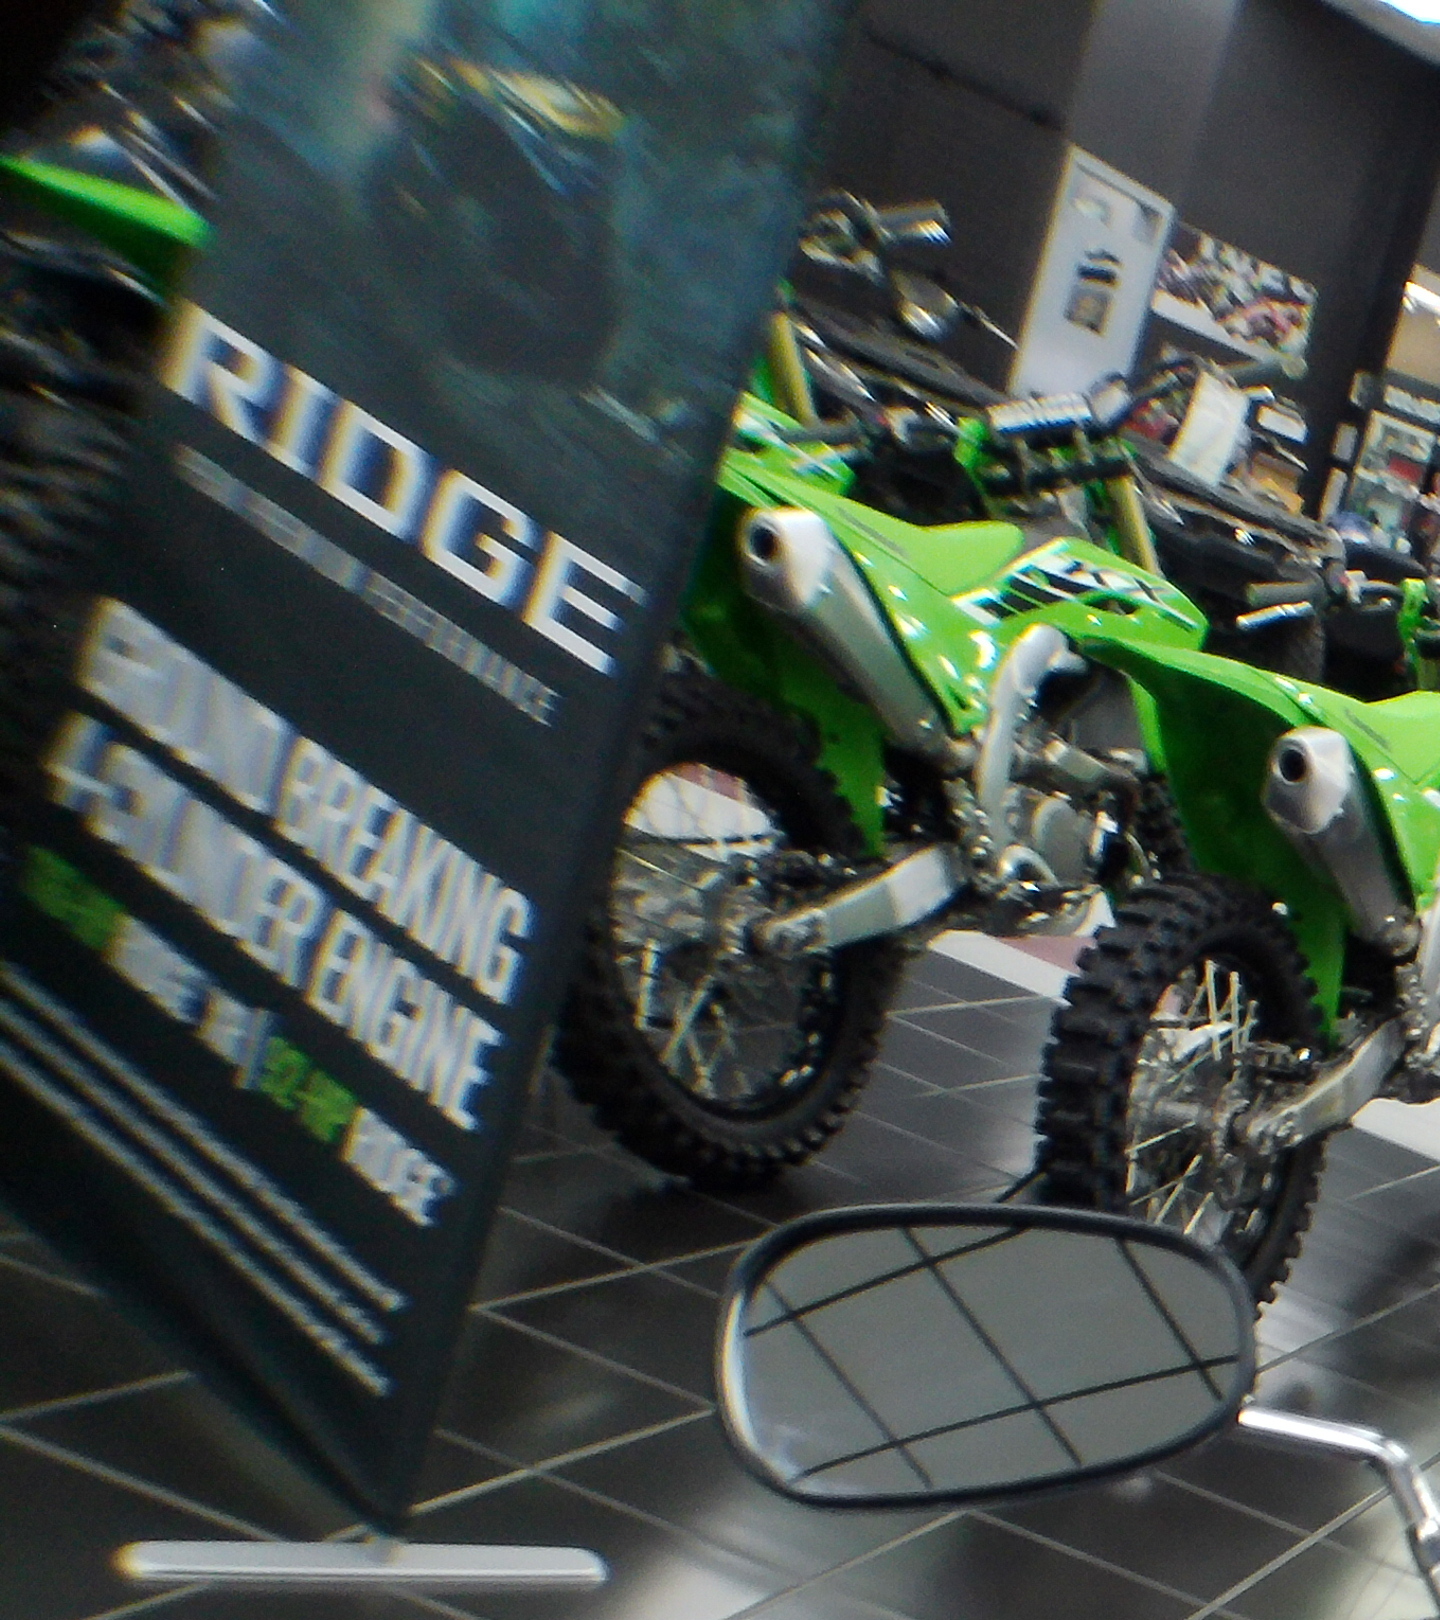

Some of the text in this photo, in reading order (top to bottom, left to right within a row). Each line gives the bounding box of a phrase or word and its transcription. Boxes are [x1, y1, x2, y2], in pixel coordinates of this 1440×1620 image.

[158, 297, 649, 676] RIDGE
[274, 732, 535, 1003] BREAKING
[305, 907, 502, 1132] ENGINE
